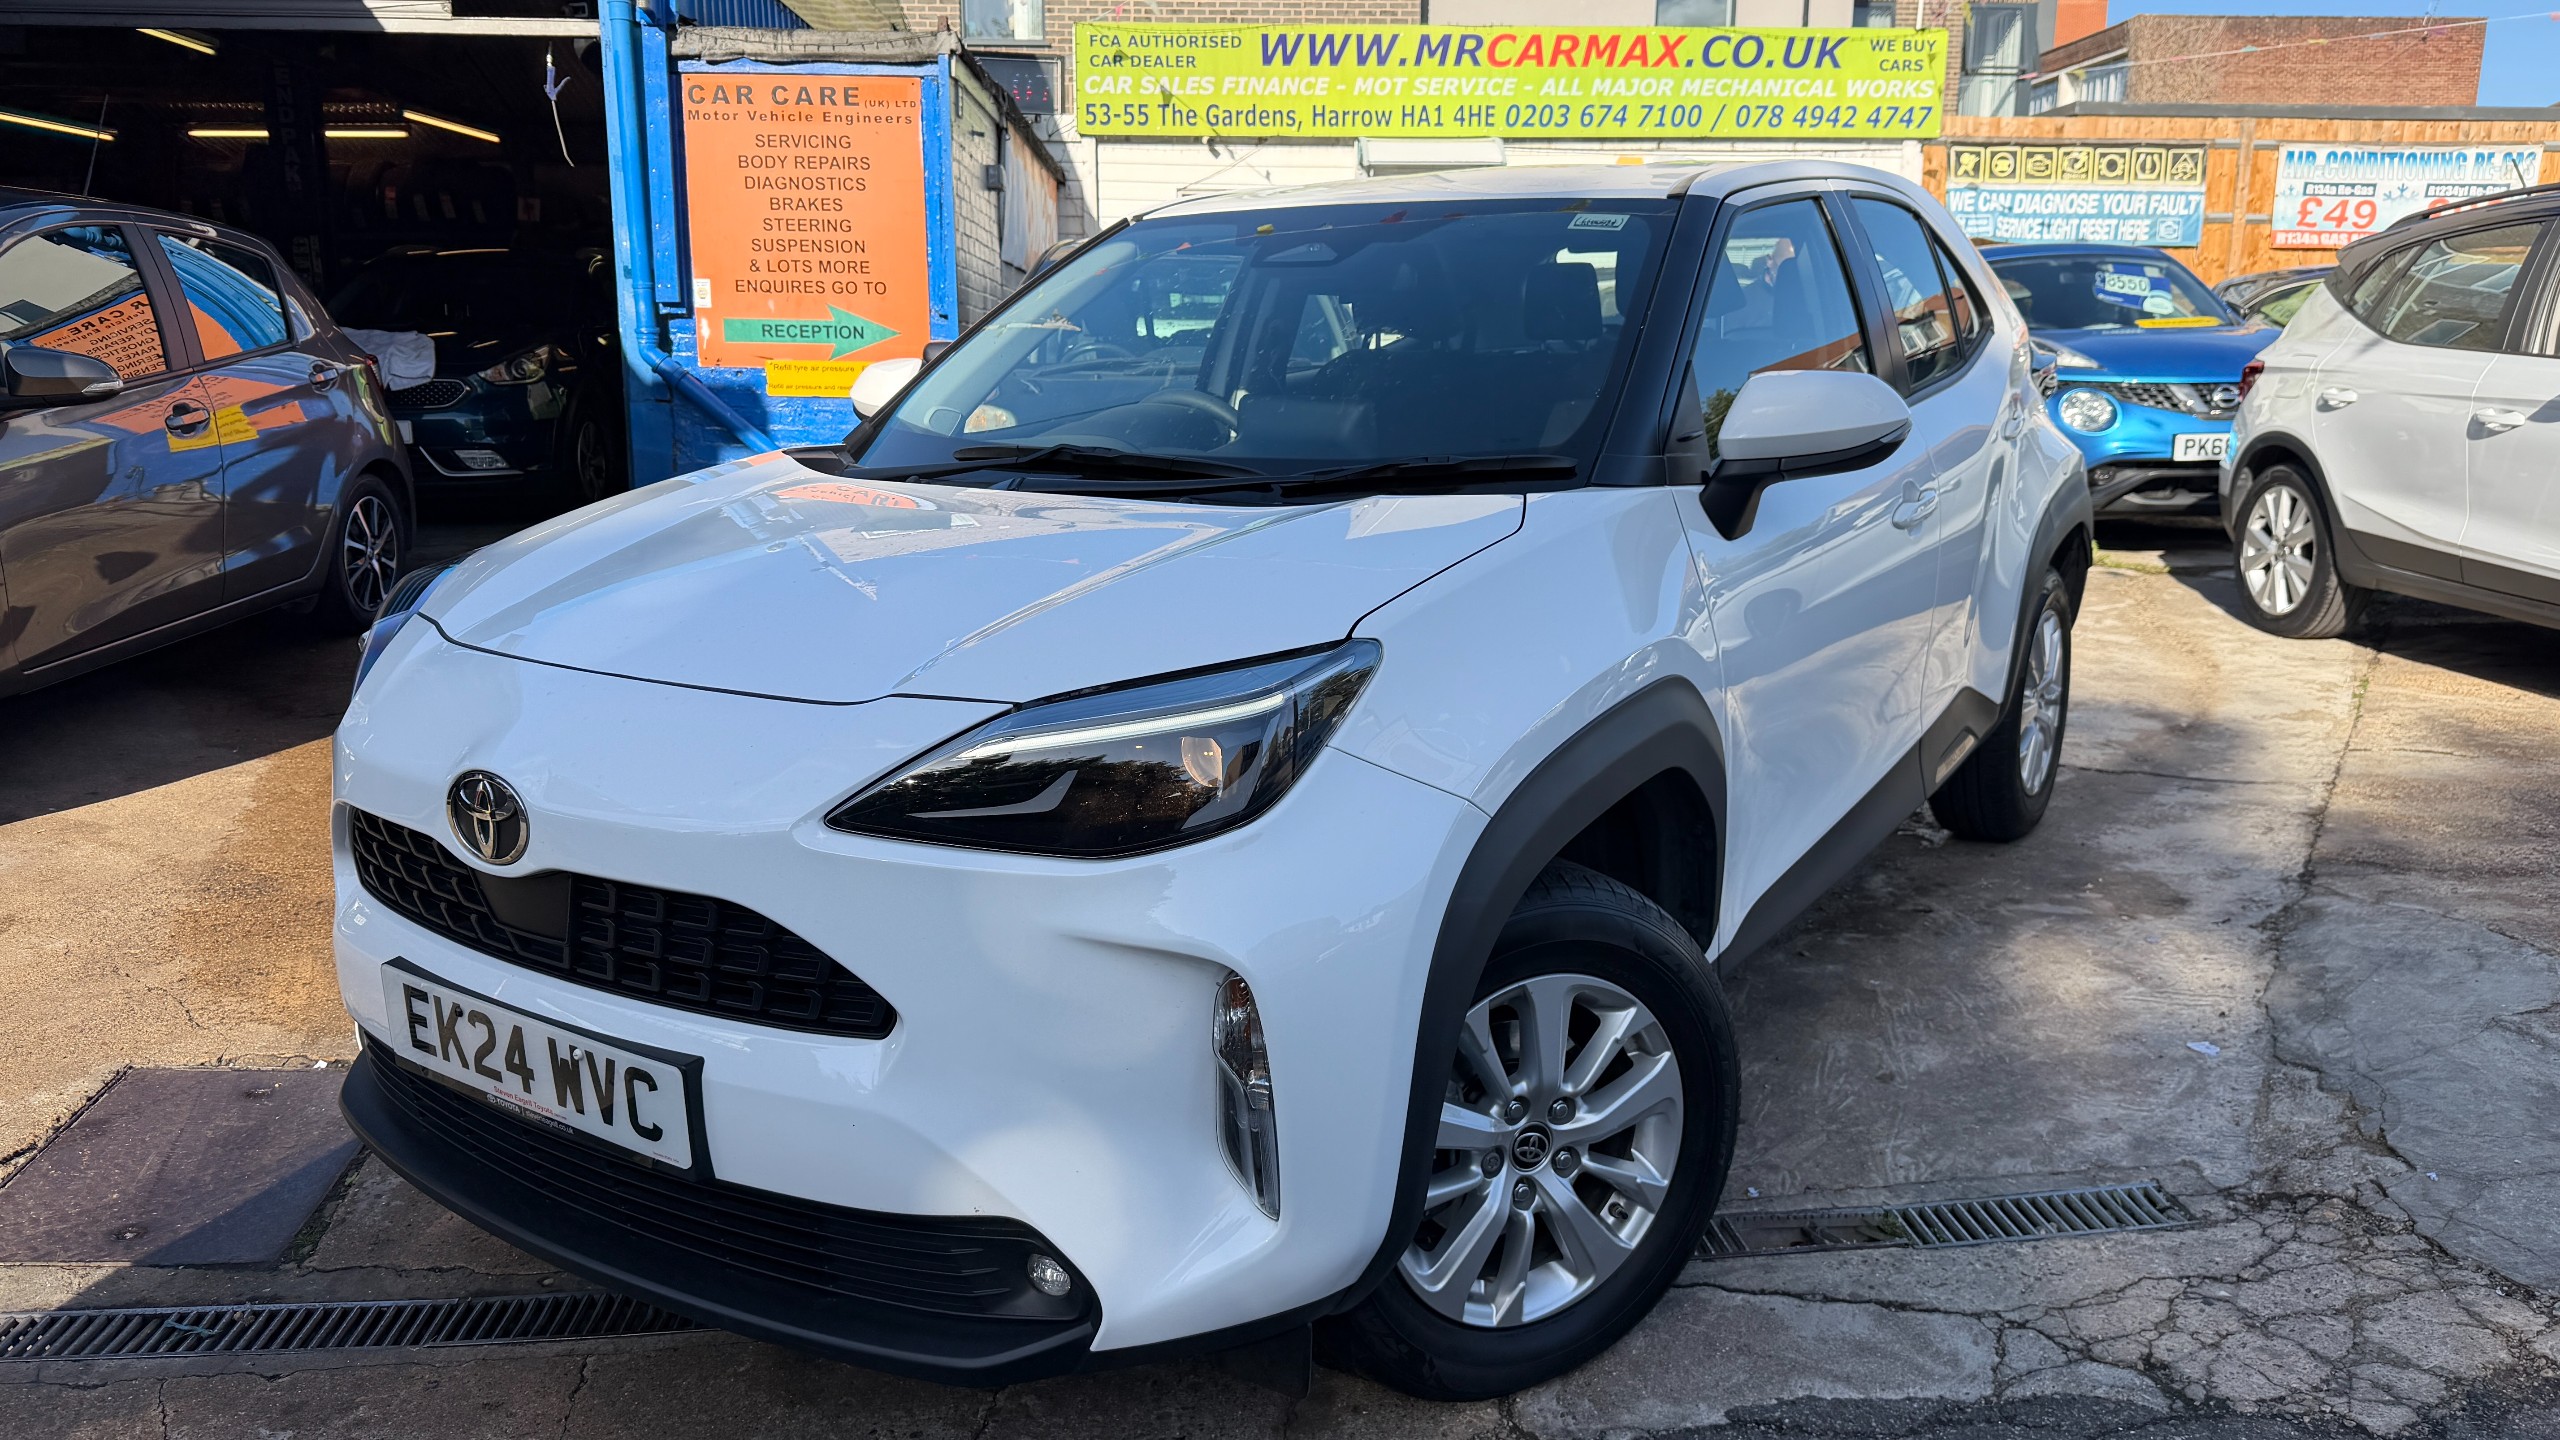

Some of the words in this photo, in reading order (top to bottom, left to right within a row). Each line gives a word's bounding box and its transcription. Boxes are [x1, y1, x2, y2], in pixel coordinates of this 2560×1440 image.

[1089, 34, 1121, 48] FCA
[1128, 34, 1242, 49] AUTHORISED
[1870, 39, 1896, 52] WE
[1902, 39, 1937, 52] BUY
[1260, 33, 1850, 69] WWW.MRCARMAX.CO.UK
[1089, 54, 1124, 68] CAR
[1130, 55, 1197, 68] DEALER
[1879, 58, 1924, 72] CARS
[1084, 75, 1132, 95] CAR
[1139, 76, 1215, 95] SALES
[1221, 76, 1330, 96] FINANCE
[1353, 77, 1409, 96] MOT
[1412, 77, 1518, 96] SERVICE
[1539, 77, 1583, 97] ALL
[1591, 77, 1674, 97] MAJOR
[1680, 78, 1837, 98] MECHANICAL
[1846, 79, 1936, 98] WORKS
[688, 84, 754, 105] CAR
[771, 86, 861, 107] CARE
[864, 99, 890, 110] (UK)
[895, 100, 917, 109] LTD
[688, 109, 739, 121] Motor
[747, 110, 814, 123] Vehicle
[822, 111, 913, 126] Engineers
[1085, 103, 1149, 126] 53-55
[1158, 104, 1198, 127] The
[1206, 104, 1302, 132] Gardens,
[1312, 104, 1392, 128] Harrow
[1401, 104, 1444, 128] HA1
[1453, 104, 1496, 128] 4HE
[1505, 104, 1571, 128] 0203
[1580, 104, 1628, 128] 674
[1638, 104, 1703, 128] 7100
[1710, 104, 1727, 132] /
[1735, 104, 1785, 128] 078
[1793, 105, 1858, 129] 4942
[1866, 106, 1933, 129] 4747
[755, 134, 852, 150] SERVICING
[738, 155, 788, 170] BODY
[794, 156, 871, 171] REPAIRS
[2471, 151, 2537, 182] RE-GAS
[744, 176, 867, 192] DIAGNOSTICS
[769, 198, 843, 212] BRAKES
[1950, 190, 1976, 212] WE
[1977, 191, 2012, 213] CAN
[2013, 192, 2099, 215] DIAGNOSE
[2102, 193, 2150, 215] YOUR
[2149, 193, 2199, 216] FAULT
[2296, 197, 2377, 230] £49
[763, 218, 852, 233] STEERING
[1996, 216, 2043, 240] SERVICE
[2042, 217, 2080, 240] LIGHT
[2079, 218, 2119, 241] RESET
[2117, 219, 2151, 241] HERE
[751, 238, 866, 254] SUSPENSION
[749, 259, 761, 274] &
[767, 259, 812, 274] LOTS
[819, 260, 871, 275] MORE
[735, 279, 826, 296] ENQUIRES
[832, 280, 859, 295] GO
[864, 280, 887, 296] TO
[761, 323, 865, 340] RECEPTION
[773, 363, 793, 371] Refill
[402, 982, 536, 1095] EK24
[547, 1036, 664, 1142] WVC
[493, 1085, 514, 1100] Steven
[533, 1101, 554, 1117] Toyota
[497, 1098, 520, 1114] TOYOTA
